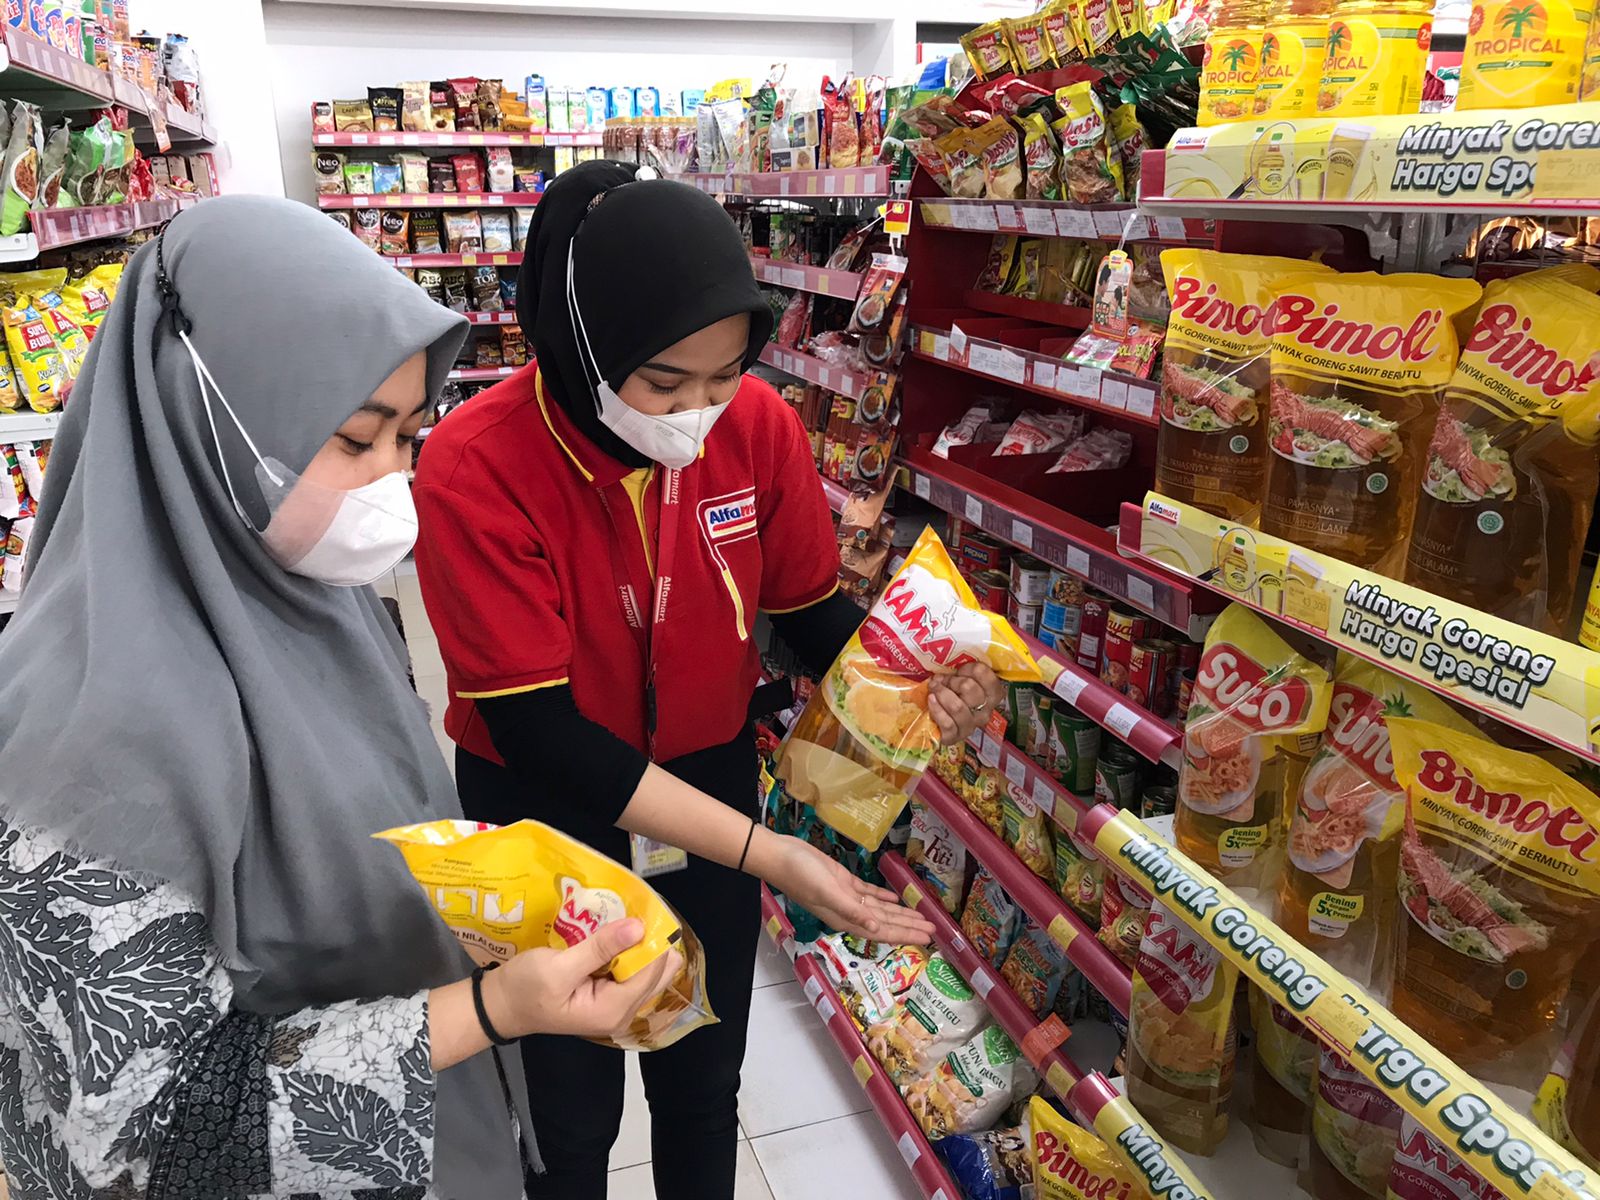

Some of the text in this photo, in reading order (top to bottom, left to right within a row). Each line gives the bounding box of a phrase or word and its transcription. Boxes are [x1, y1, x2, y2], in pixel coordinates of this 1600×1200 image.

[1474, 38, 1565, 57] TROPICAL
[1205, 70, 1259, 84] TROPICA
[1397, 121, 1511, 159] Minyak
[1391, 158, 1485, 195] Harga
[1184, 328, 1220, 346] GORENG
[1220, 339, 1247, 352] SAWIT
[1271, 293, 1443, 363] Bimoli
[1304, 355, 1347, 371] GORENG
[1348, 364, 1379, 376] SAWIT
[1379, 369, 1422, 380] BERUTU
[1484, 377, 1518, 401] GORENG
[709, 504, 756, 525] Alfam
[1149, 502, 1179, 520] Alfamart
[963, 545, 988, 562] PRONAS
[619, 584, 638, 628] Alfamart
[659, 575, 671, 623] Alfamart
[1343, 579, 1556, 687] Minyak Goreng
[882, 635, 907, 665] GORENG
[1340, 608, 1532, 711] Harga Spesial
[1416, 749, 1599, 863] Bimoli
[1225, 836, 1241, 849] 5x
[1419, 796, 1578, 877] MINYAK GORENG SAWIT BERMUTU
[1316, 900, 1333, 916] 5x
[1325, 894, 1357, 909] Bening
[1120, 835, 1221, 920] Minyak
[1212, 906, 1328, 1011] Goreng
[461, 932, 487, 947] NILAI
[488, 942, 507, 956] GIZI
[865, 971, 879, 993] TANI
[935, 963, 965, 992] Sania
[1349, 1087, 1389, 1109] GORENG
[1116, 1123, 1208, 1200] Minya
